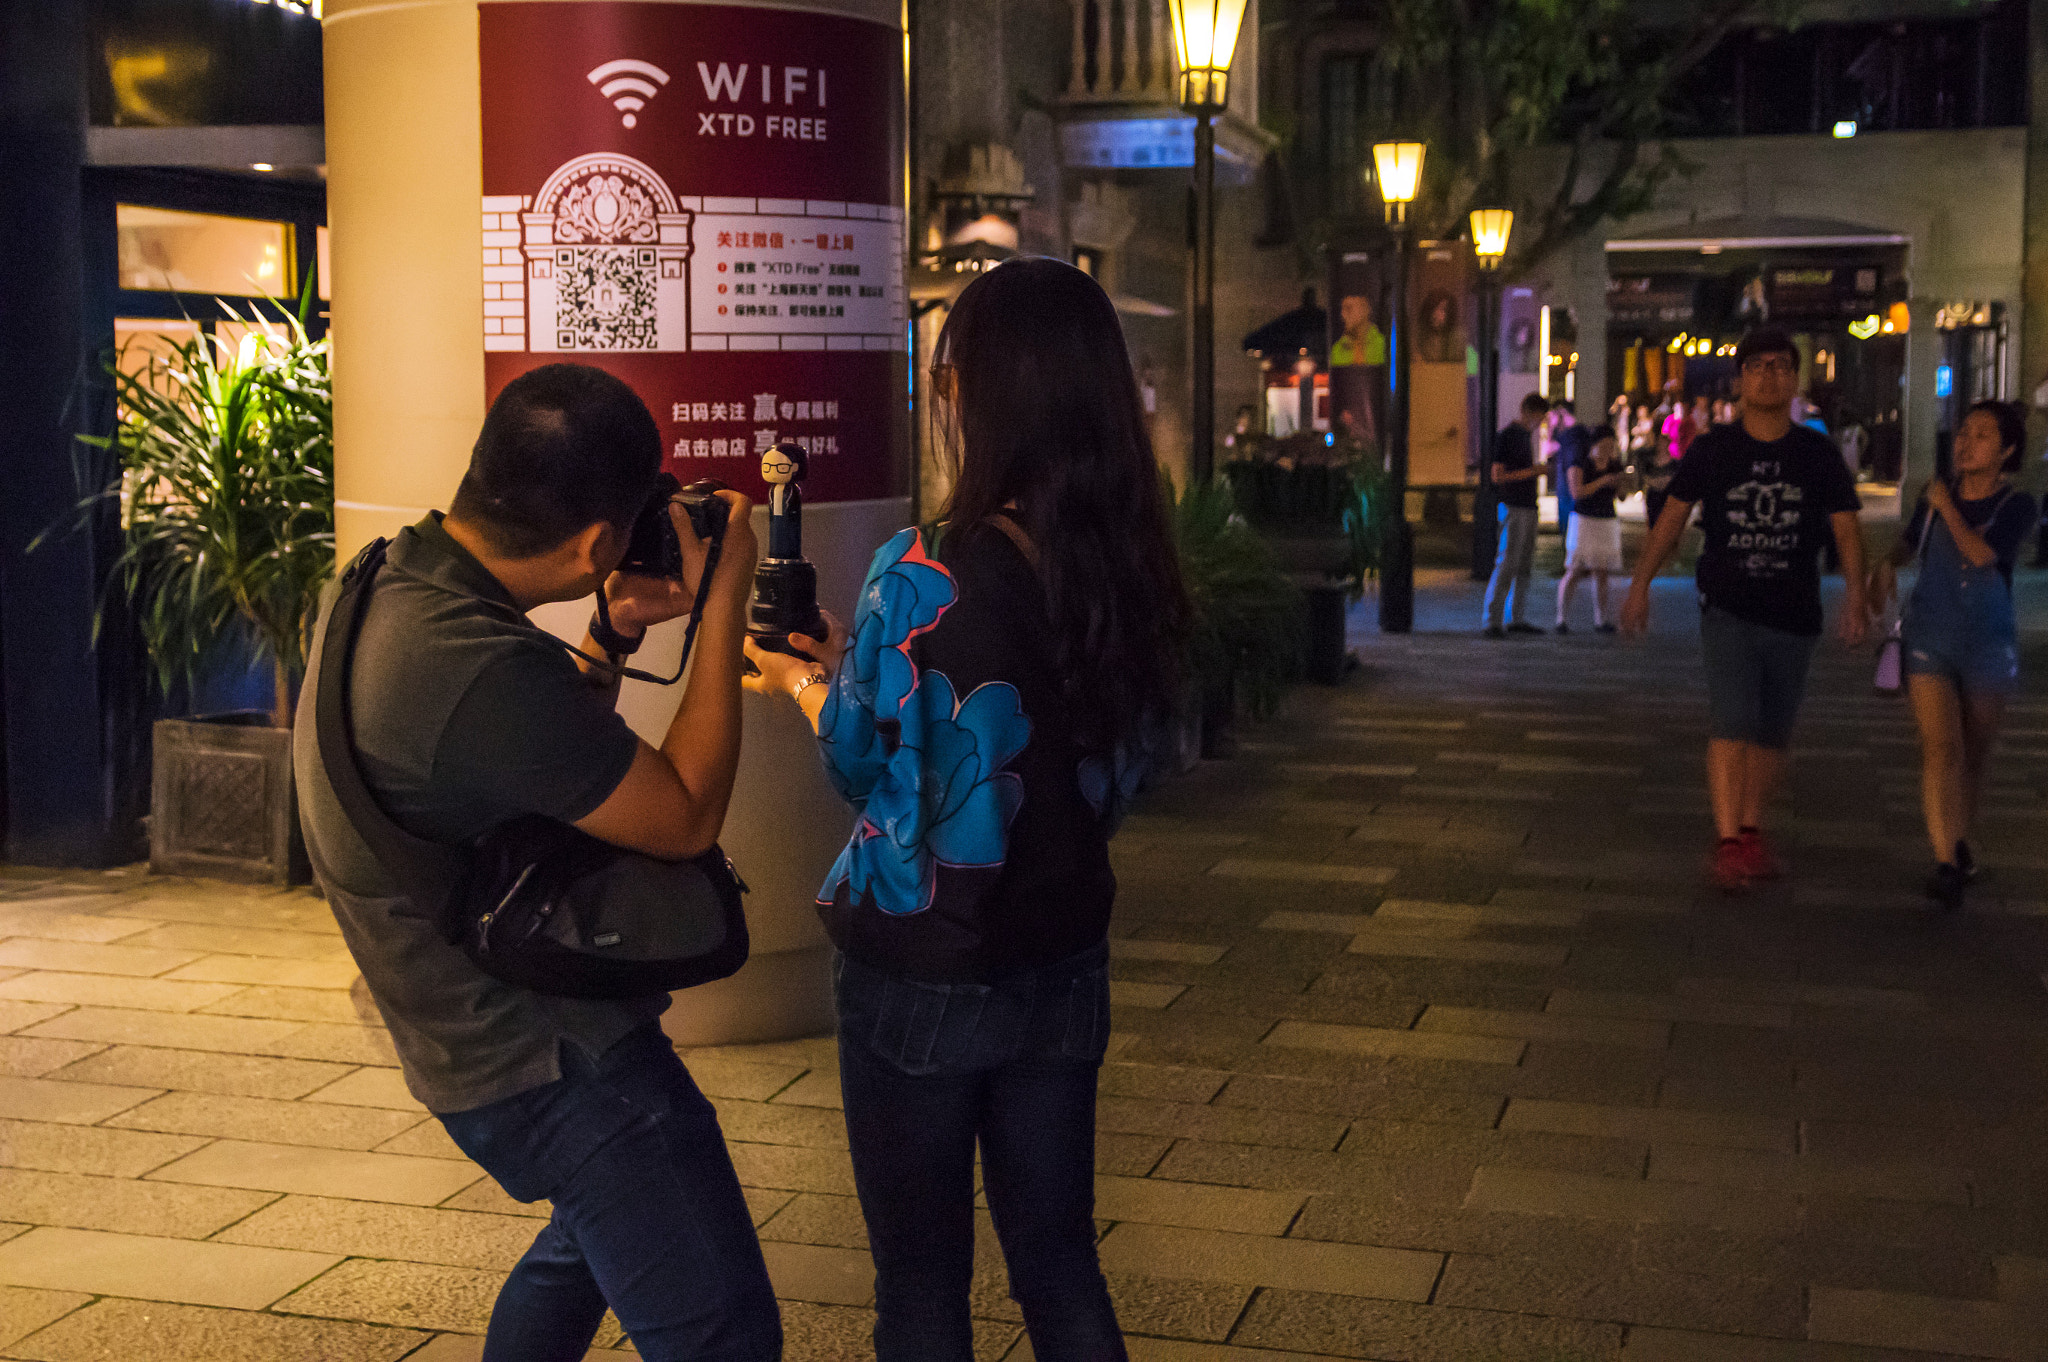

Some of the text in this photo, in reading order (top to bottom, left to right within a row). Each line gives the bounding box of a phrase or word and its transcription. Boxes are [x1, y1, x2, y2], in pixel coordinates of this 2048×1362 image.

[697, 61, 826, 108] WIFI
[697, 112, 827, 140] XTD FREE
[673, 437, 747, 459] 点击微店
